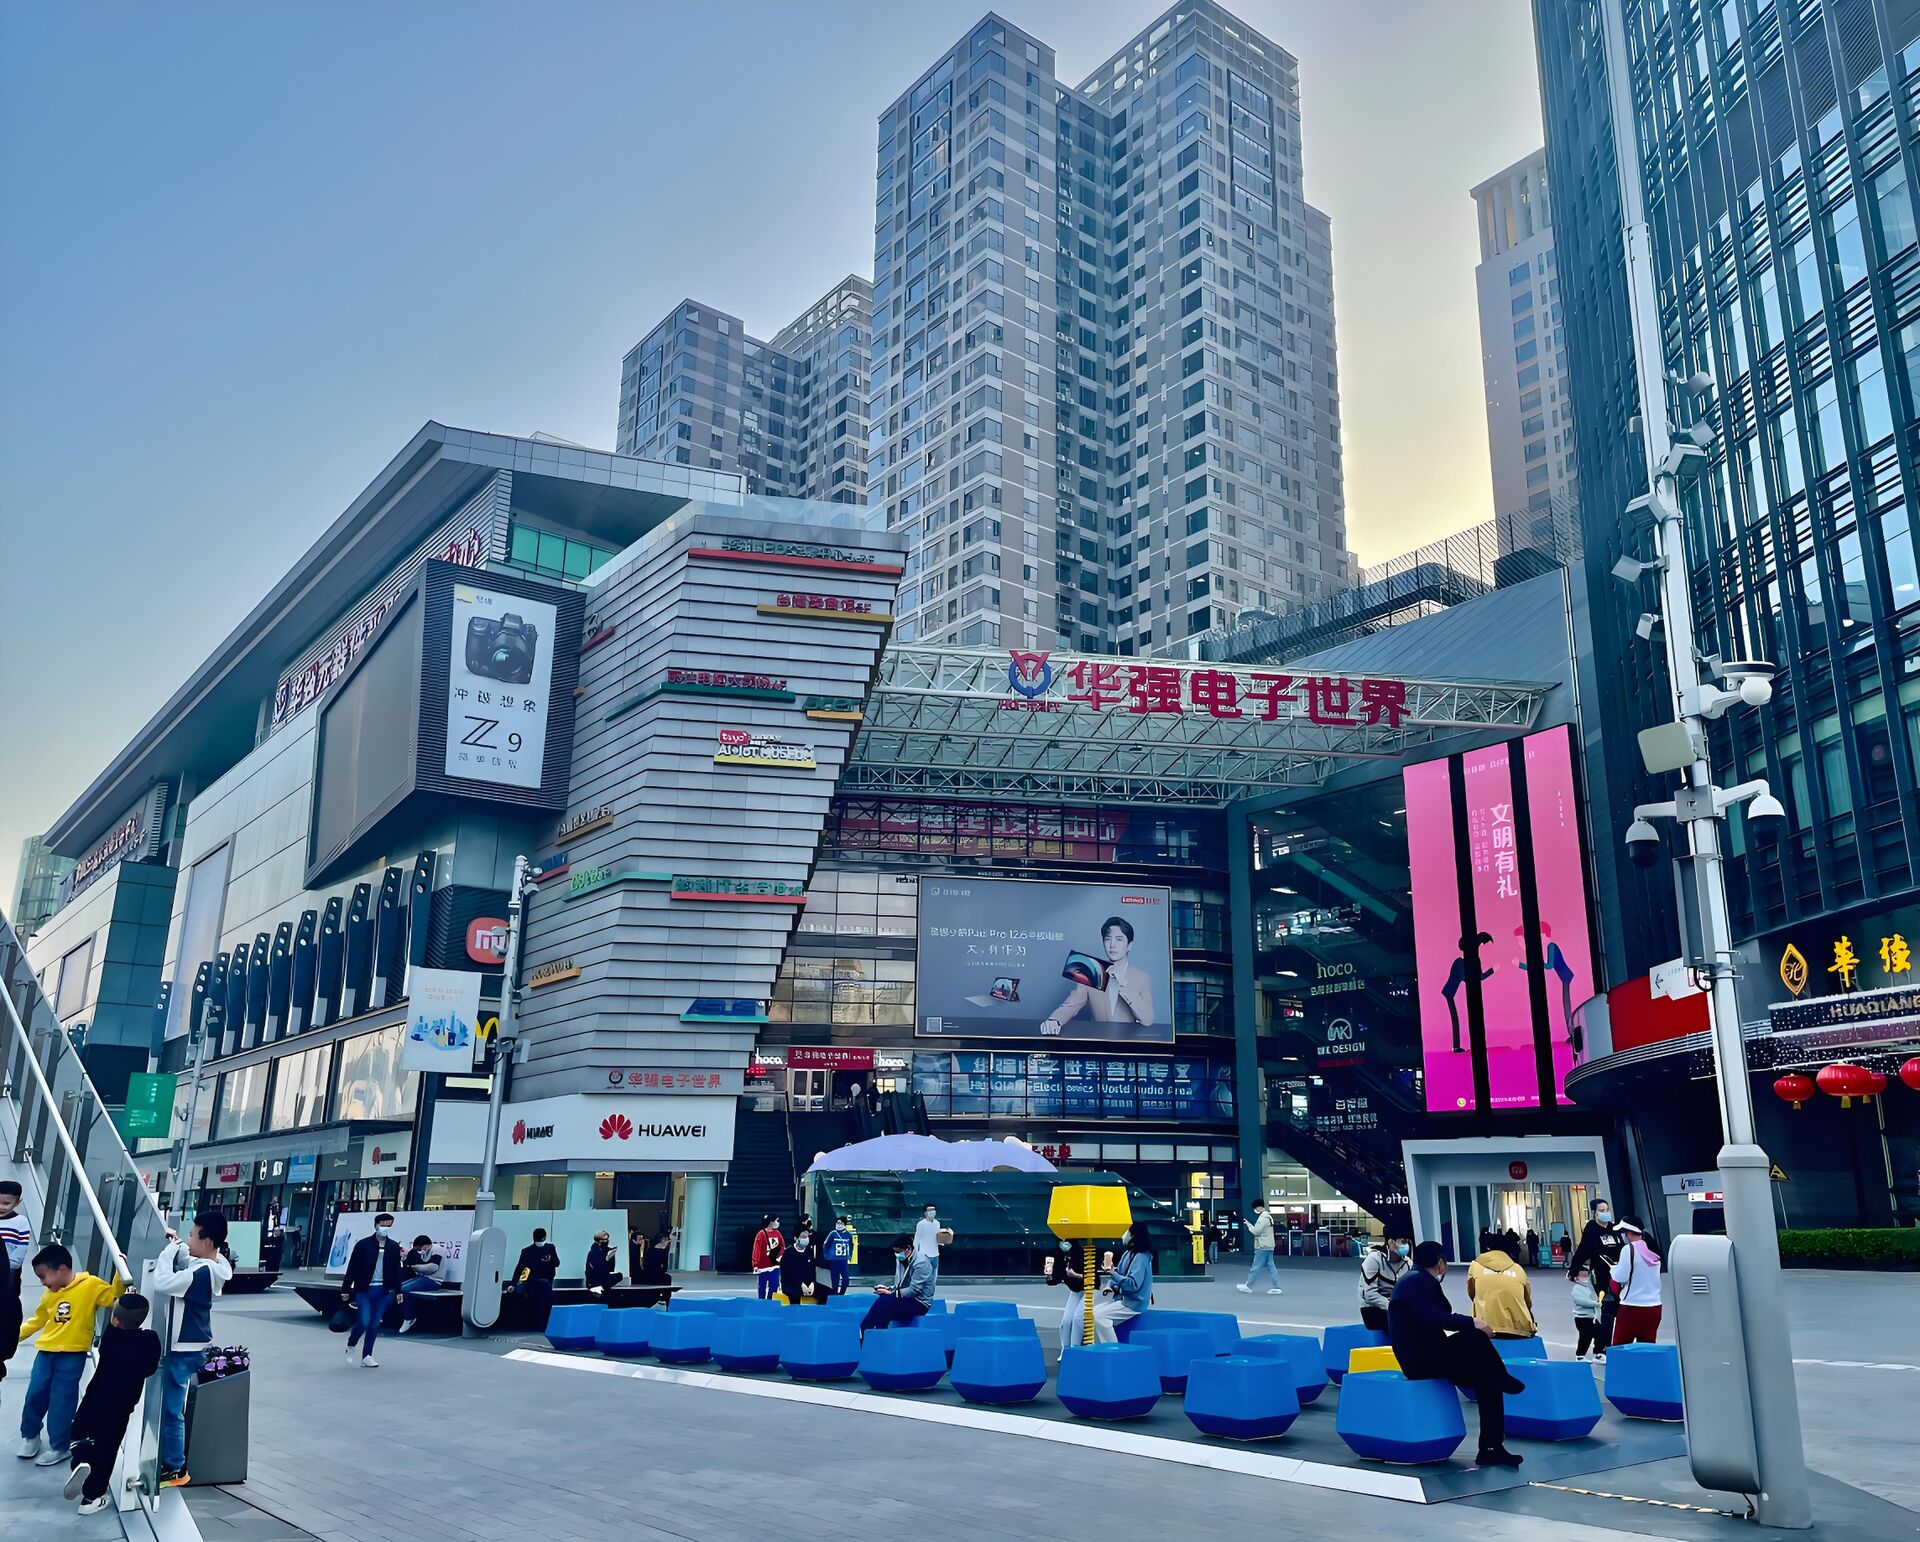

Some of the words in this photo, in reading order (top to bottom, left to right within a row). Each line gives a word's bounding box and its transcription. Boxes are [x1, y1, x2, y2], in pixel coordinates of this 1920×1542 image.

[1067, 660, 1410, 728] 华强电子世界
[460, 715, 499, 749] Z
[508, 733, 522, 752] 9
[1490, 803, 1518, 899] 文明有礼
[1317, 963, 1357, 979] hoco.
[1332, 1042, 1365, 1054] DESIGN
[628, 1072, 722, 1088] 华强电子世界
[638, 1124, 706, 1138] HUAWEI
